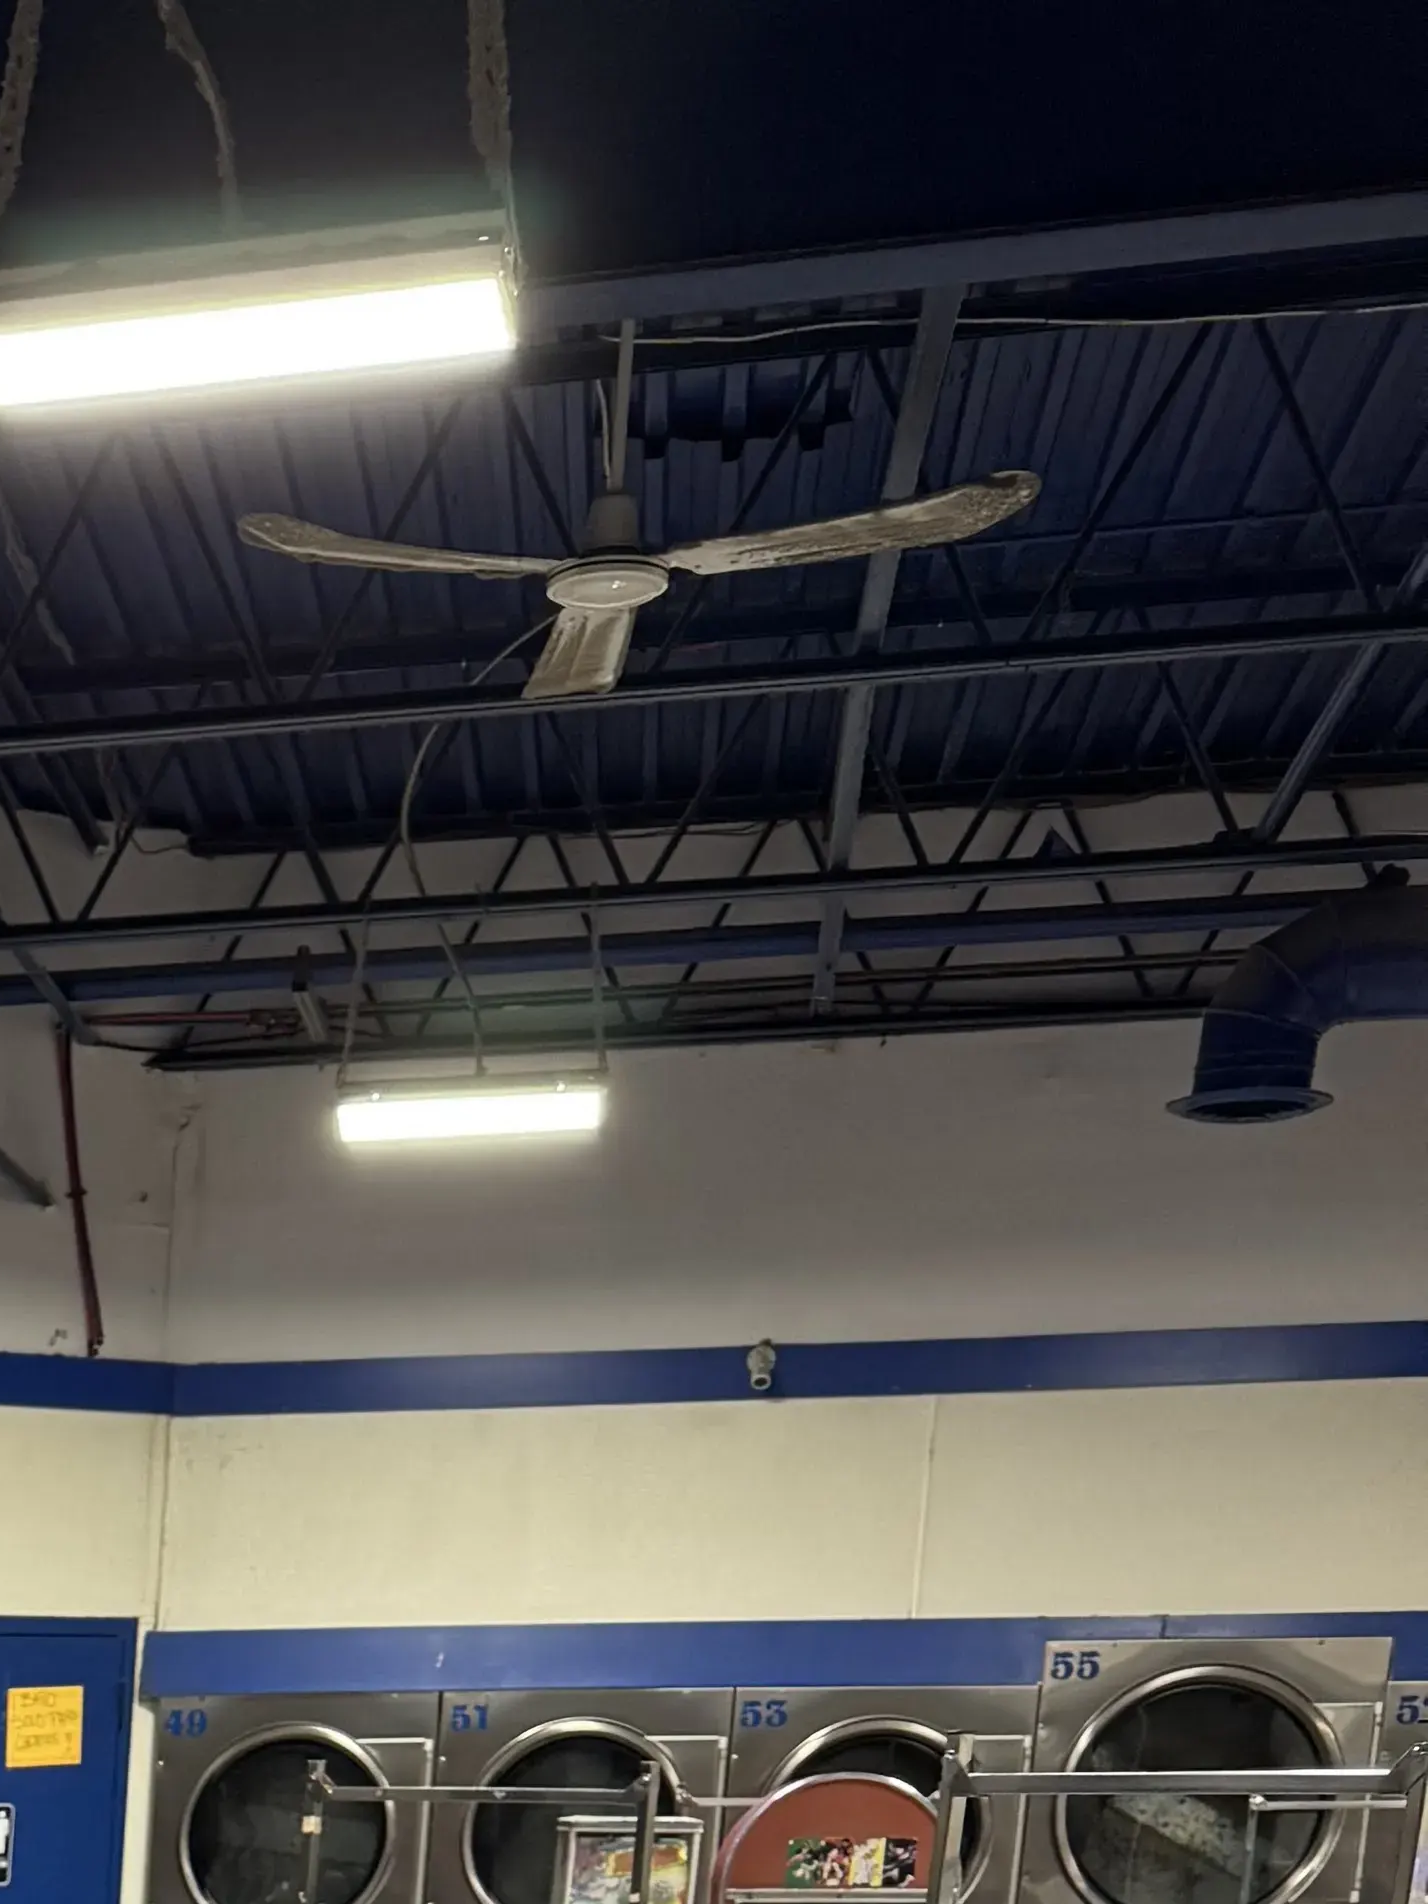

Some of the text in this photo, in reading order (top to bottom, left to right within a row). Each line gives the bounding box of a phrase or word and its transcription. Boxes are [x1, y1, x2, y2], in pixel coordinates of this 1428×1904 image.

[1051, 1651, 1100, 1680] 55
[165, 1708, 207, 1737] 49
[450, 1704, 489, 1732] 51
[740, 1700, 788, 1728] 53
[1397, 1695, 1428, 1725] 5
